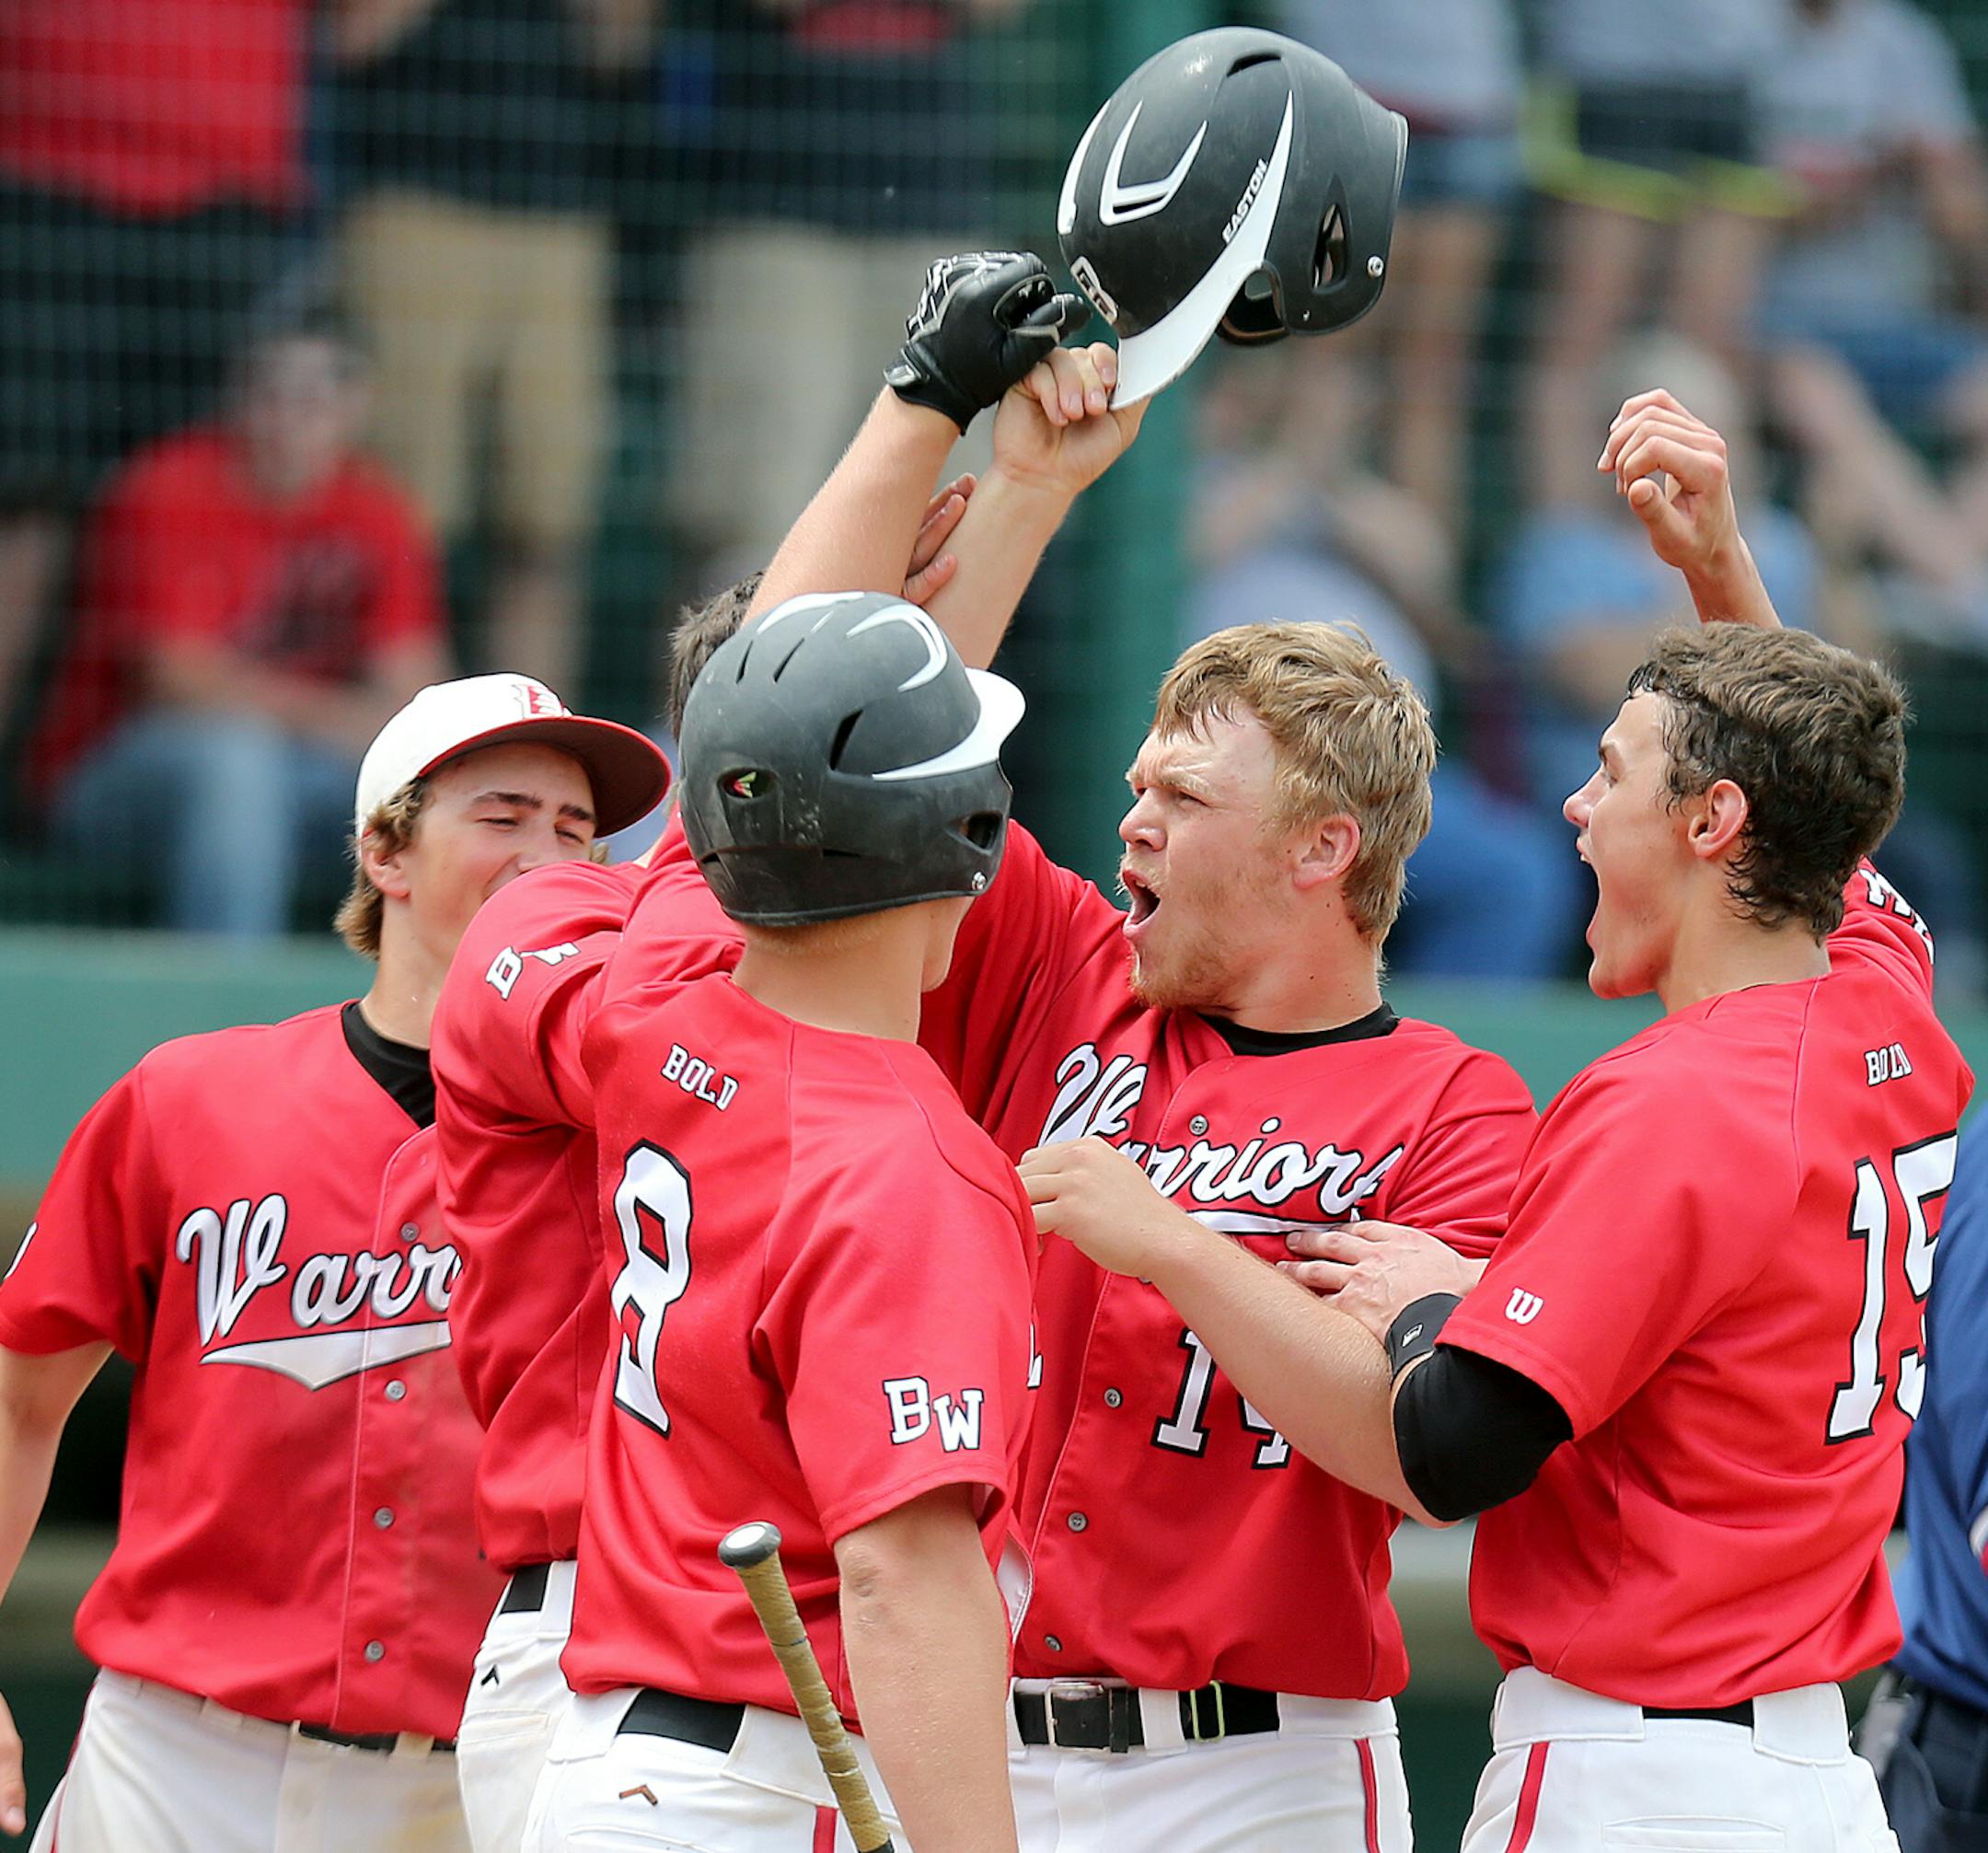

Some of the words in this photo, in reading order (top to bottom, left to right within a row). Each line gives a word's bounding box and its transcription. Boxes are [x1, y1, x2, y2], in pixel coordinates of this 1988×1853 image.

[1221, 157, 1268, 244] EASTON
[661, 1042, 739, 1111] BOLD
[1864, 1041, 1913, 1087] BOLD
[176, 1193, 463, 1347] Warr
[884, 1376, 983, 1453] BW
